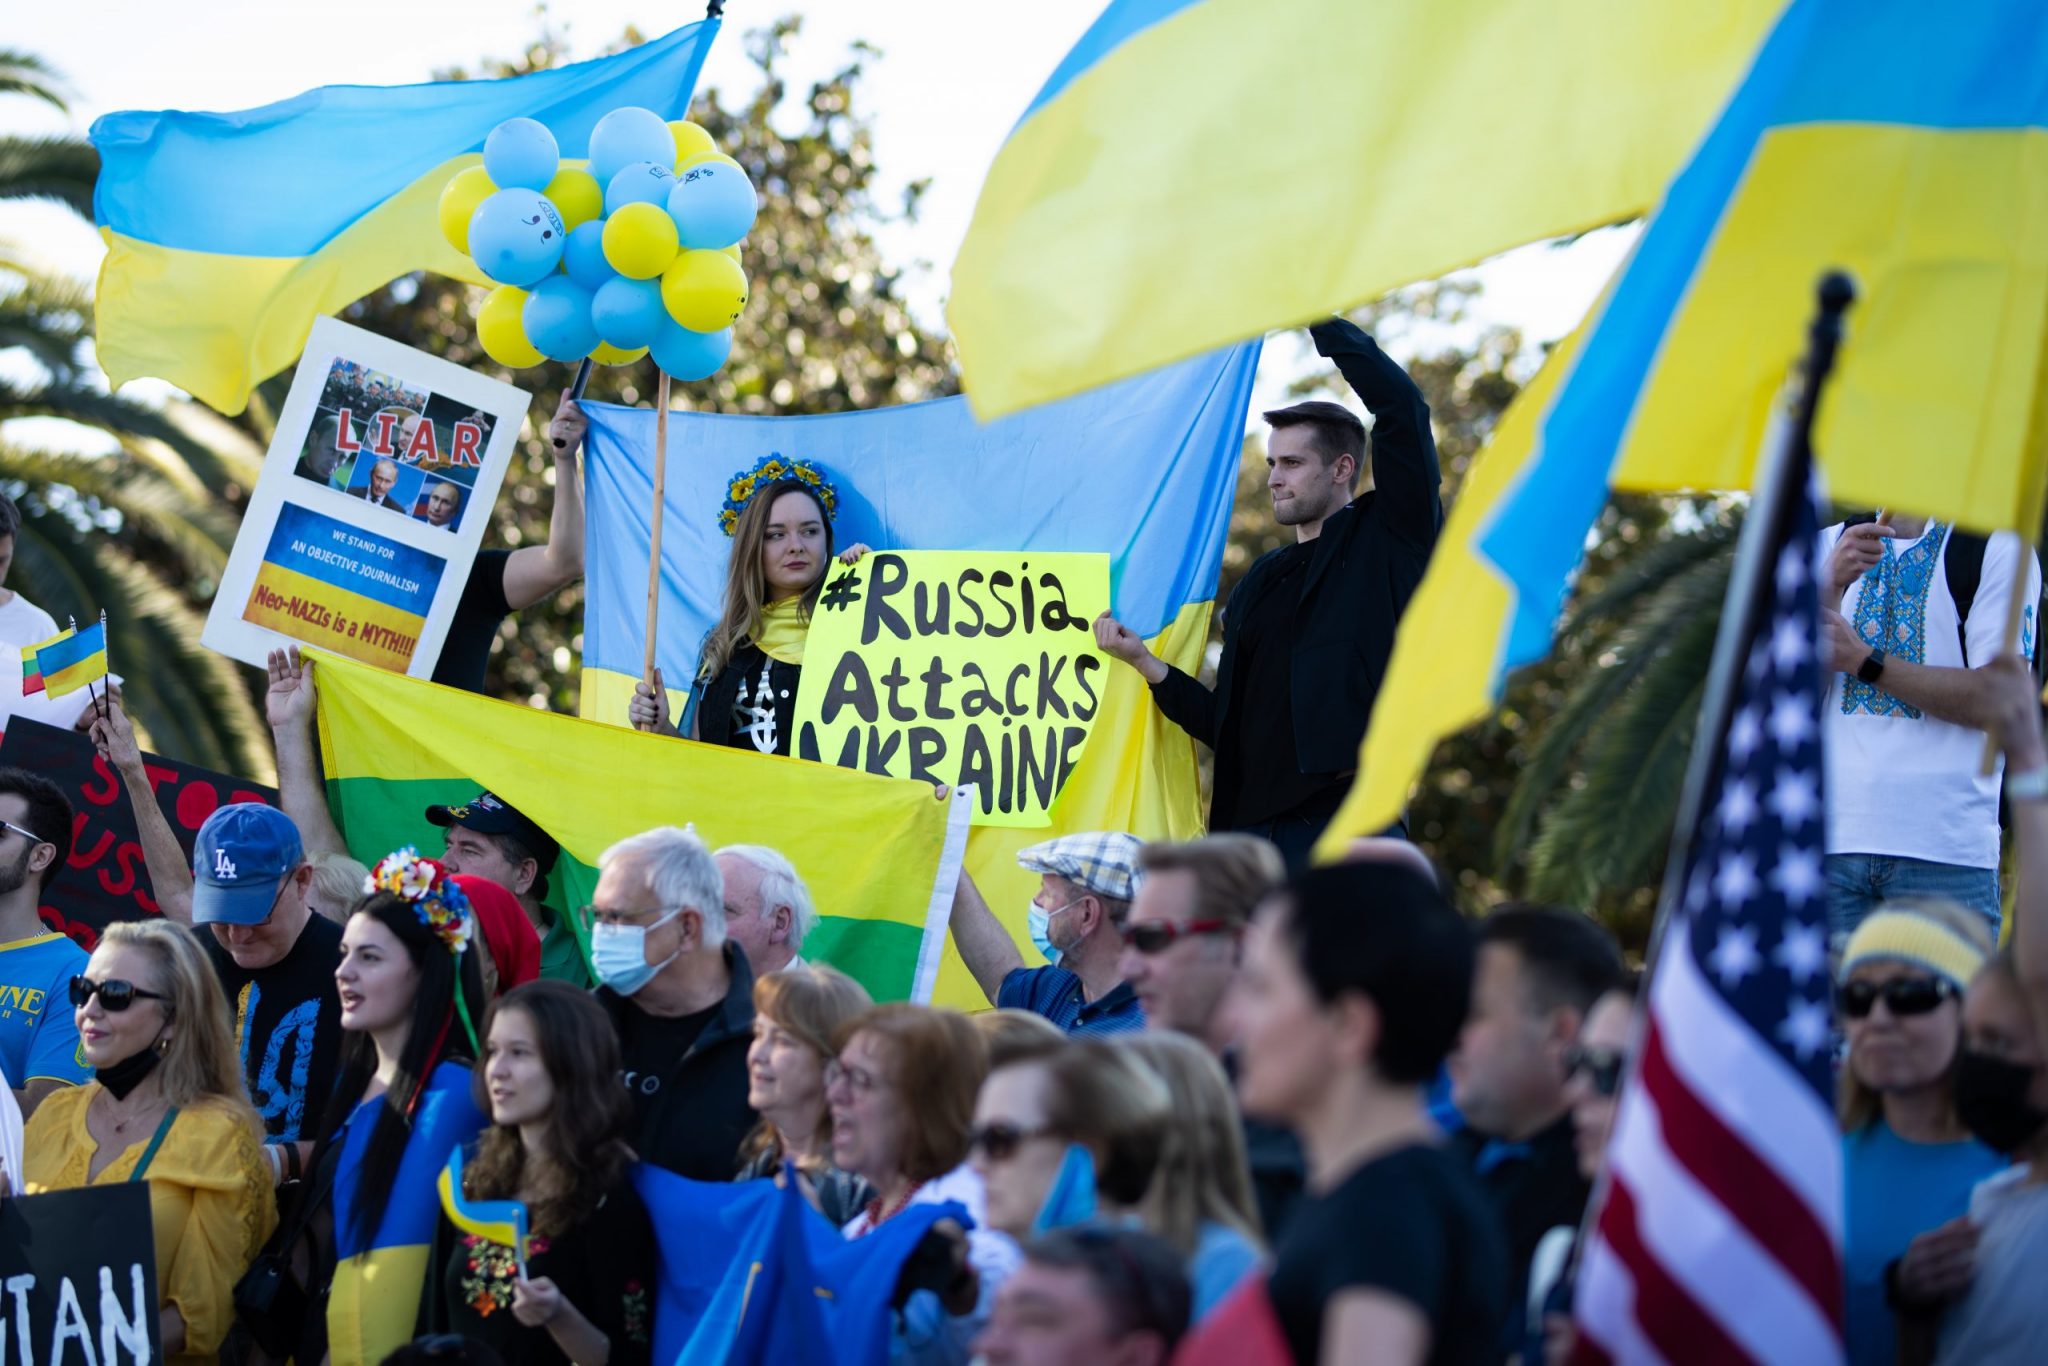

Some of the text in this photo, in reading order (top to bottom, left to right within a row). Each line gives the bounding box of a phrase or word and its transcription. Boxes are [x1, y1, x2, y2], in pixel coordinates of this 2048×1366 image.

[336, 408, 484, 468] LIAR
[291, 539, 420, 595] AN OBJECTIVE JOURNALISM
[332, 529, 395, 560] WE STAND FOR
[254, 584, 417, 658] Neo-NAZIs is a MYTH!!!
[820, 554, 1090, 645] #Russia
[81, 752, 268, 830] STO
[215, 849, 238, 879] LA
[0, 1263, 152, 1366] TAN
